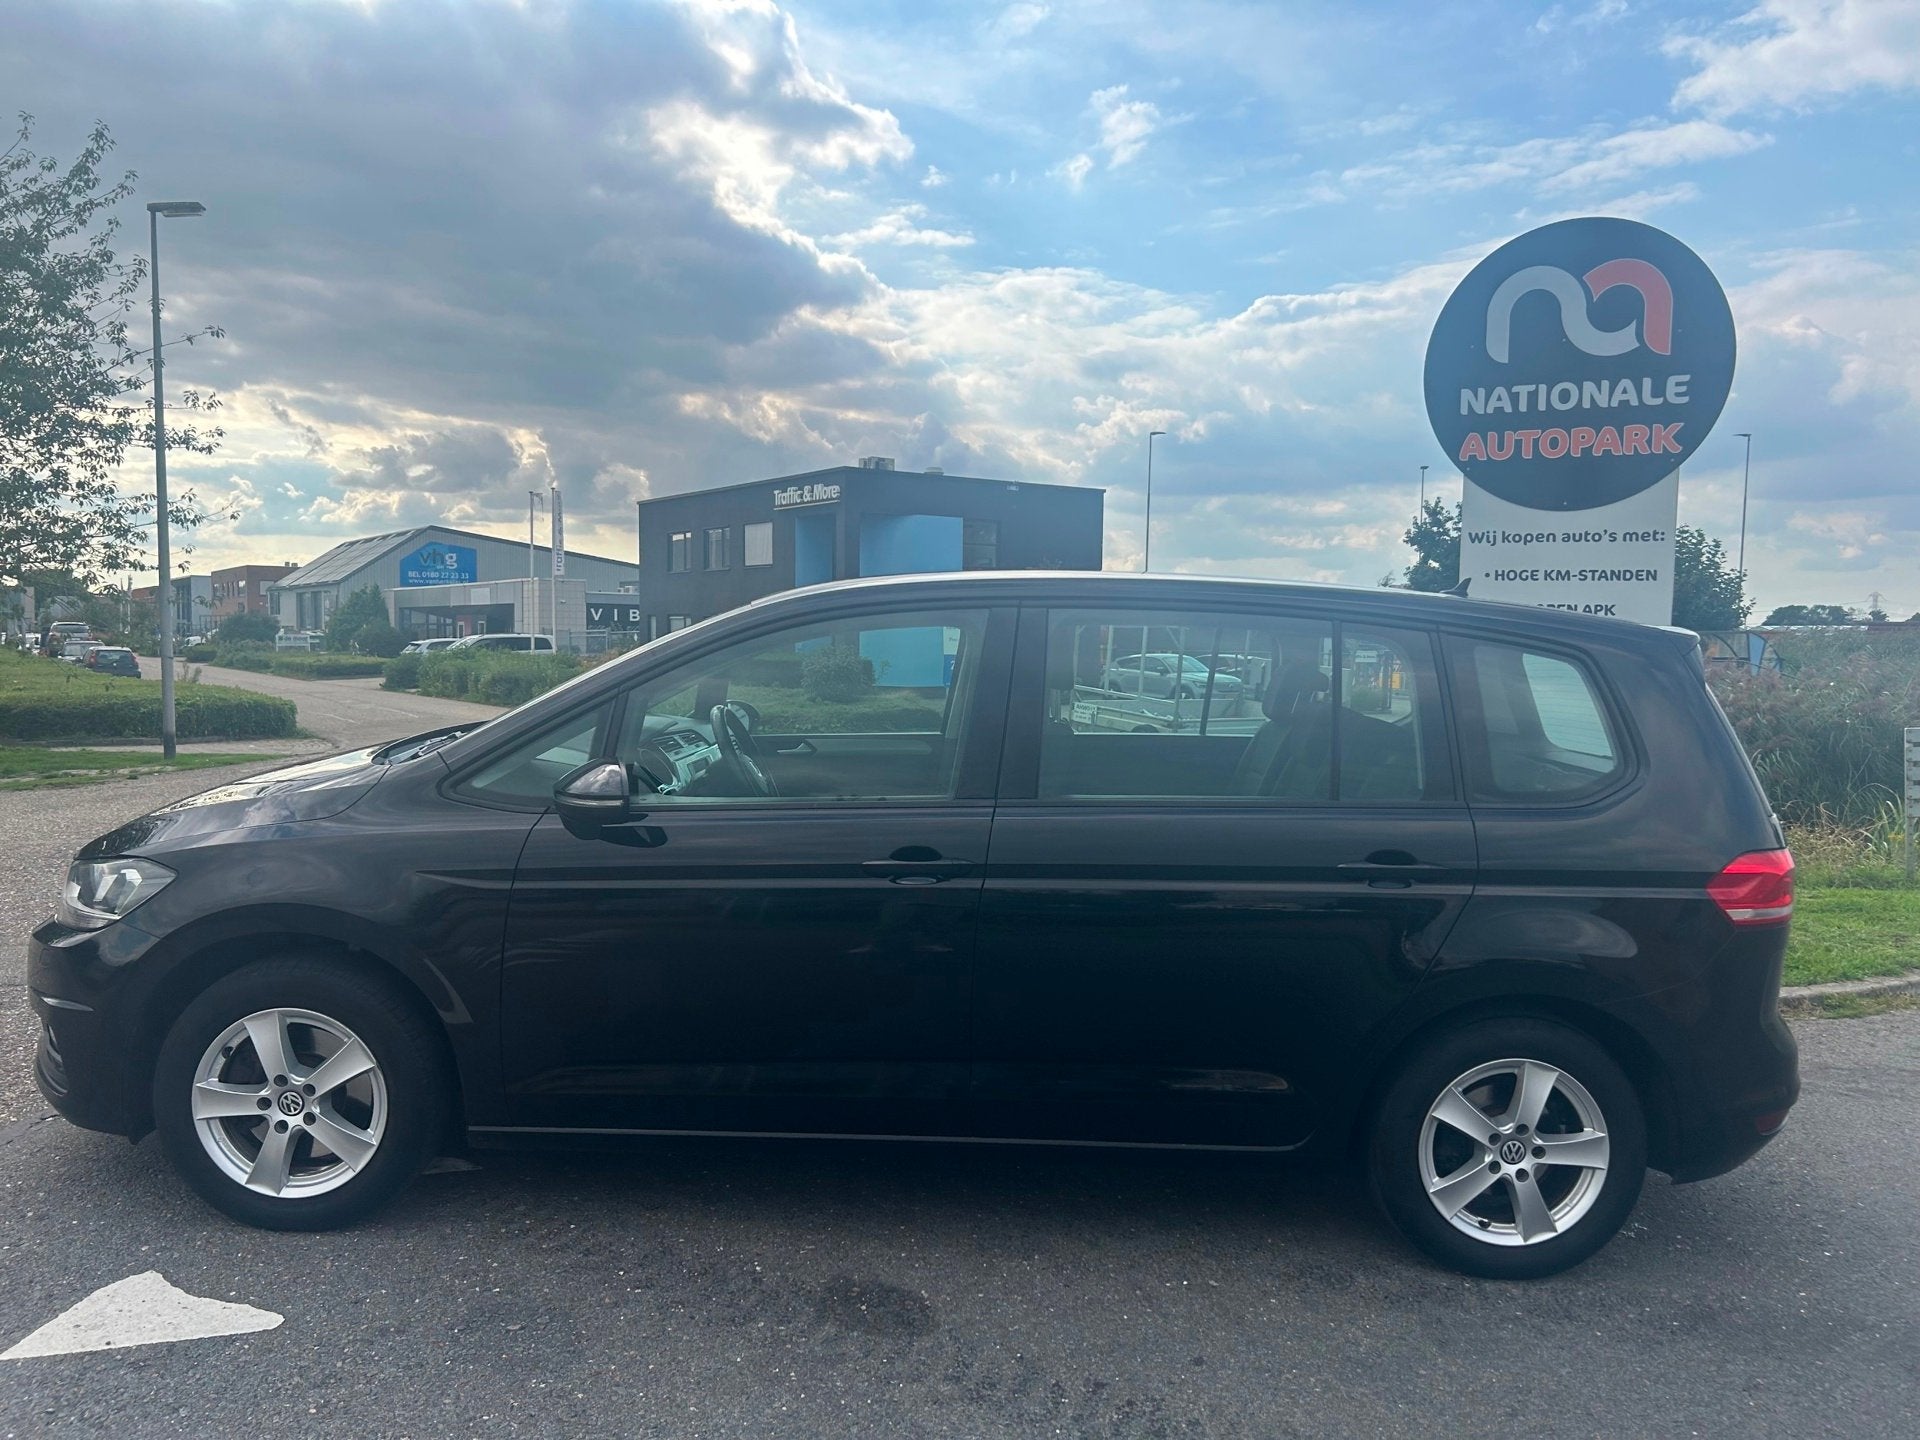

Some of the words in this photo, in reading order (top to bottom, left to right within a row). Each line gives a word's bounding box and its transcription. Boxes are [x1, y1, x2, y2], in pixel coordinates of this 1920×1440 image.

[1460, 374, 1691, 415] NATIONALE
[1458, 422, 1685, 462] AUTOPARK
[773, 486, 803, 505] Traffic
[803, 485, 812, 501] &
[813, 483, 840, 501] More
[1468, 530, 1497, 546] Wij
[1501, 530, 1556, 545] kopen
[1561, 529, 1617, 543] auto's
[1622, 529, 1665, 542] met:
[1494, 569, 1539, 582] HOGE
[1543, 569, 1658, 582] KM-STANDEN
[1582, 603, 1616, 616] APK
